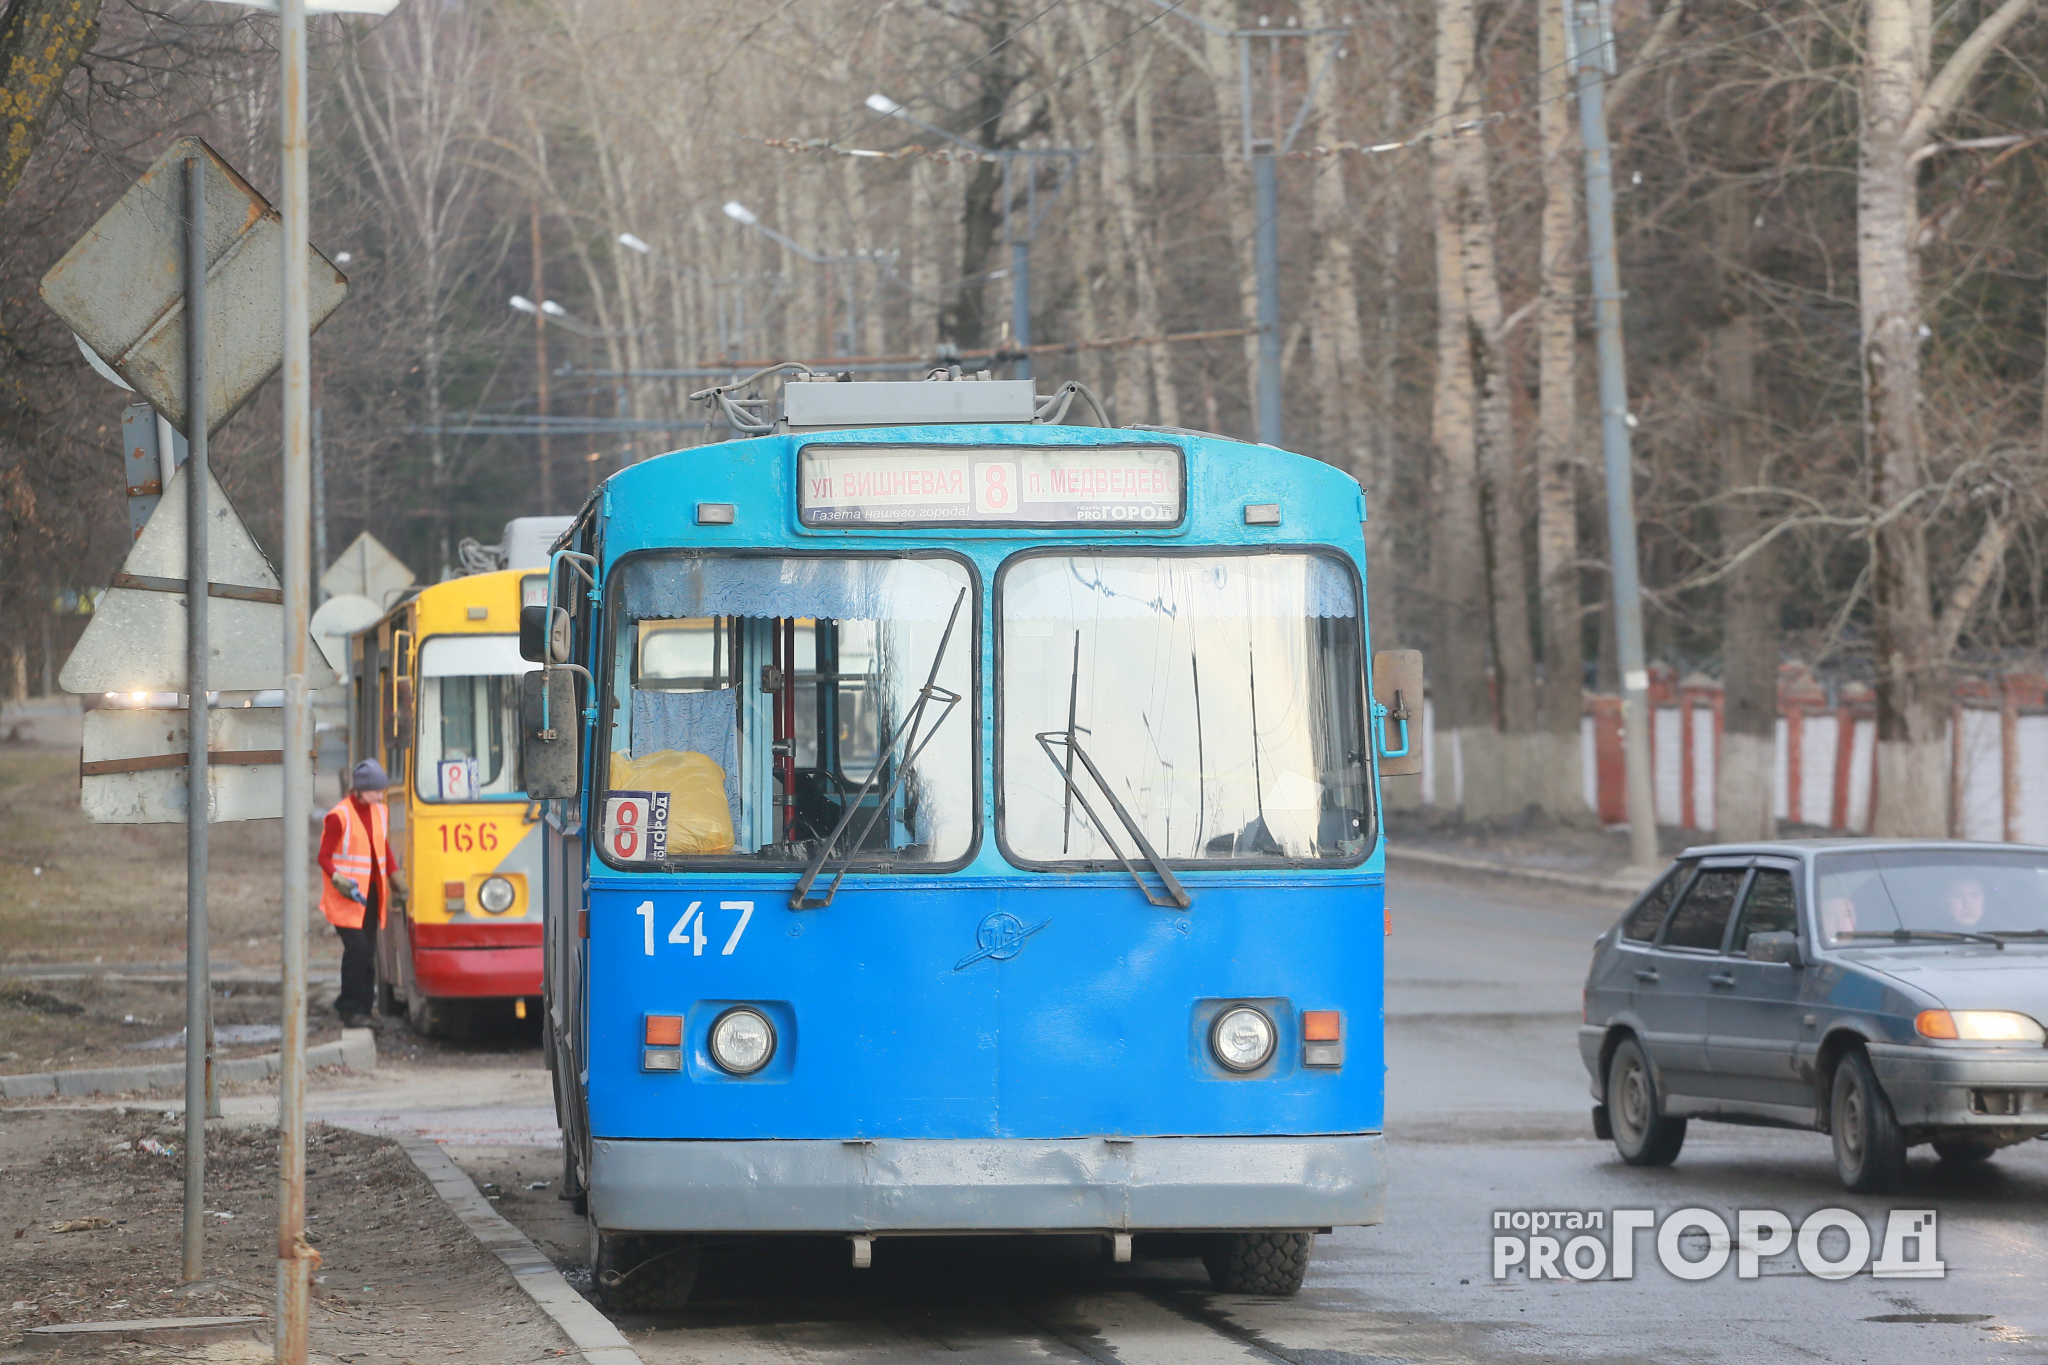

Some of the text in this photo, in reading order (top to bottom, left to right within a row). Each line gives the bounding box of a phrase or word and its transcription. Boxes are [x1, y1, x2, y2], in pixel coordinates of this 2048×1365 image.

[843, 469, 963, 498] ВИШНЕВАЯ
[985, 464, 1009, 509] 8
[812, 505, 970, 521] Газета нашего города!
[438, 822, 498, 853] 166
[614, 801, 639, 858] 8
[636, 900, 755, 956] 147
